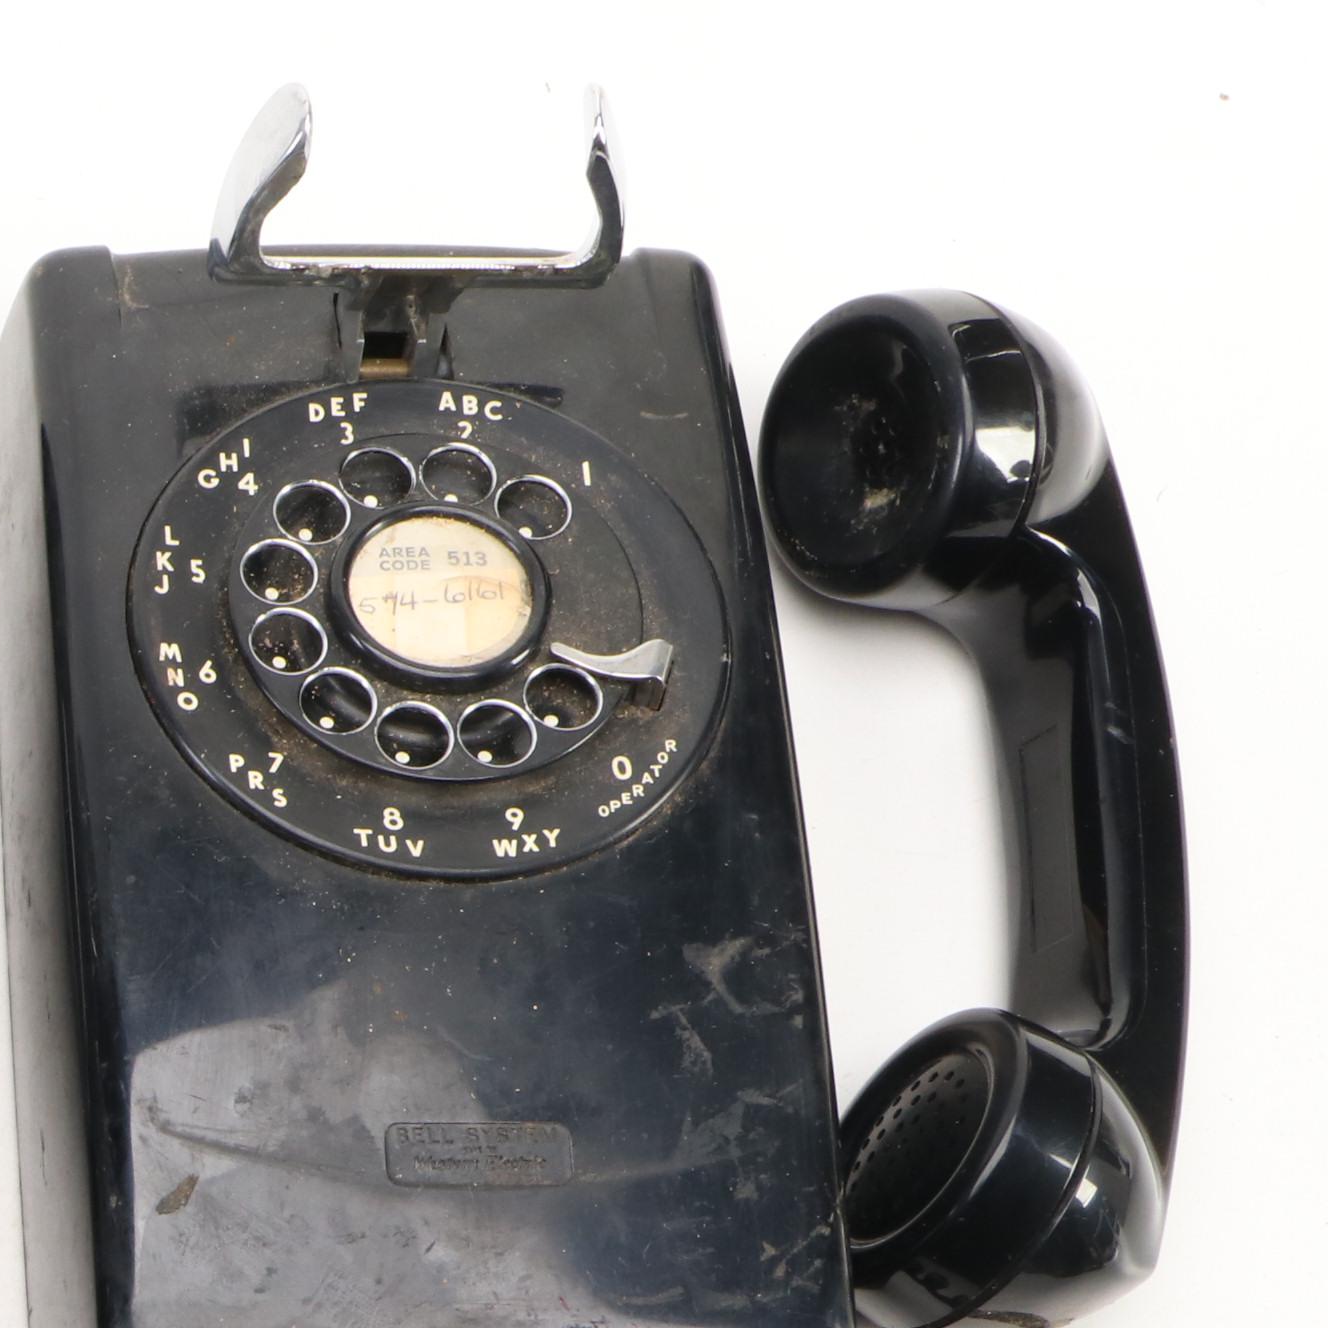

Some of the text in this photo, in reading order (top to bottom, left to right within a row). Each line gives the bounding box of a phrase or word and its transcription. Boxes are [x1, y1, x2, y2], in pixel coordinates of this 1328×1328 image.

[308, 392, 368, 424] DEF
[438, 391, 503, 422] ABC
[339, 421, 355, 446] 3
[197, 437, 252, 490] GHI
[235, 471, 259, 496] 4
[378, 546, 431, 559] AREA
[447, 551, 488, 567] 513
[189, 558, 206, 584] 5
[379, 559, 431, 572] CODE
[198, 659, 217, 684] 6
[267, 751, 286, 774] 7
[228, 752, 288, 808] PRS
[597, 738, 678, 818] OPERATOR
[382, 807, 405, 831] 8
[504, 807, 525, 832] 9
[352, 827, 426, 859] TUV
[492, 827, 562, 859] WXY
[397, 1127, 455, 1145] BELL
